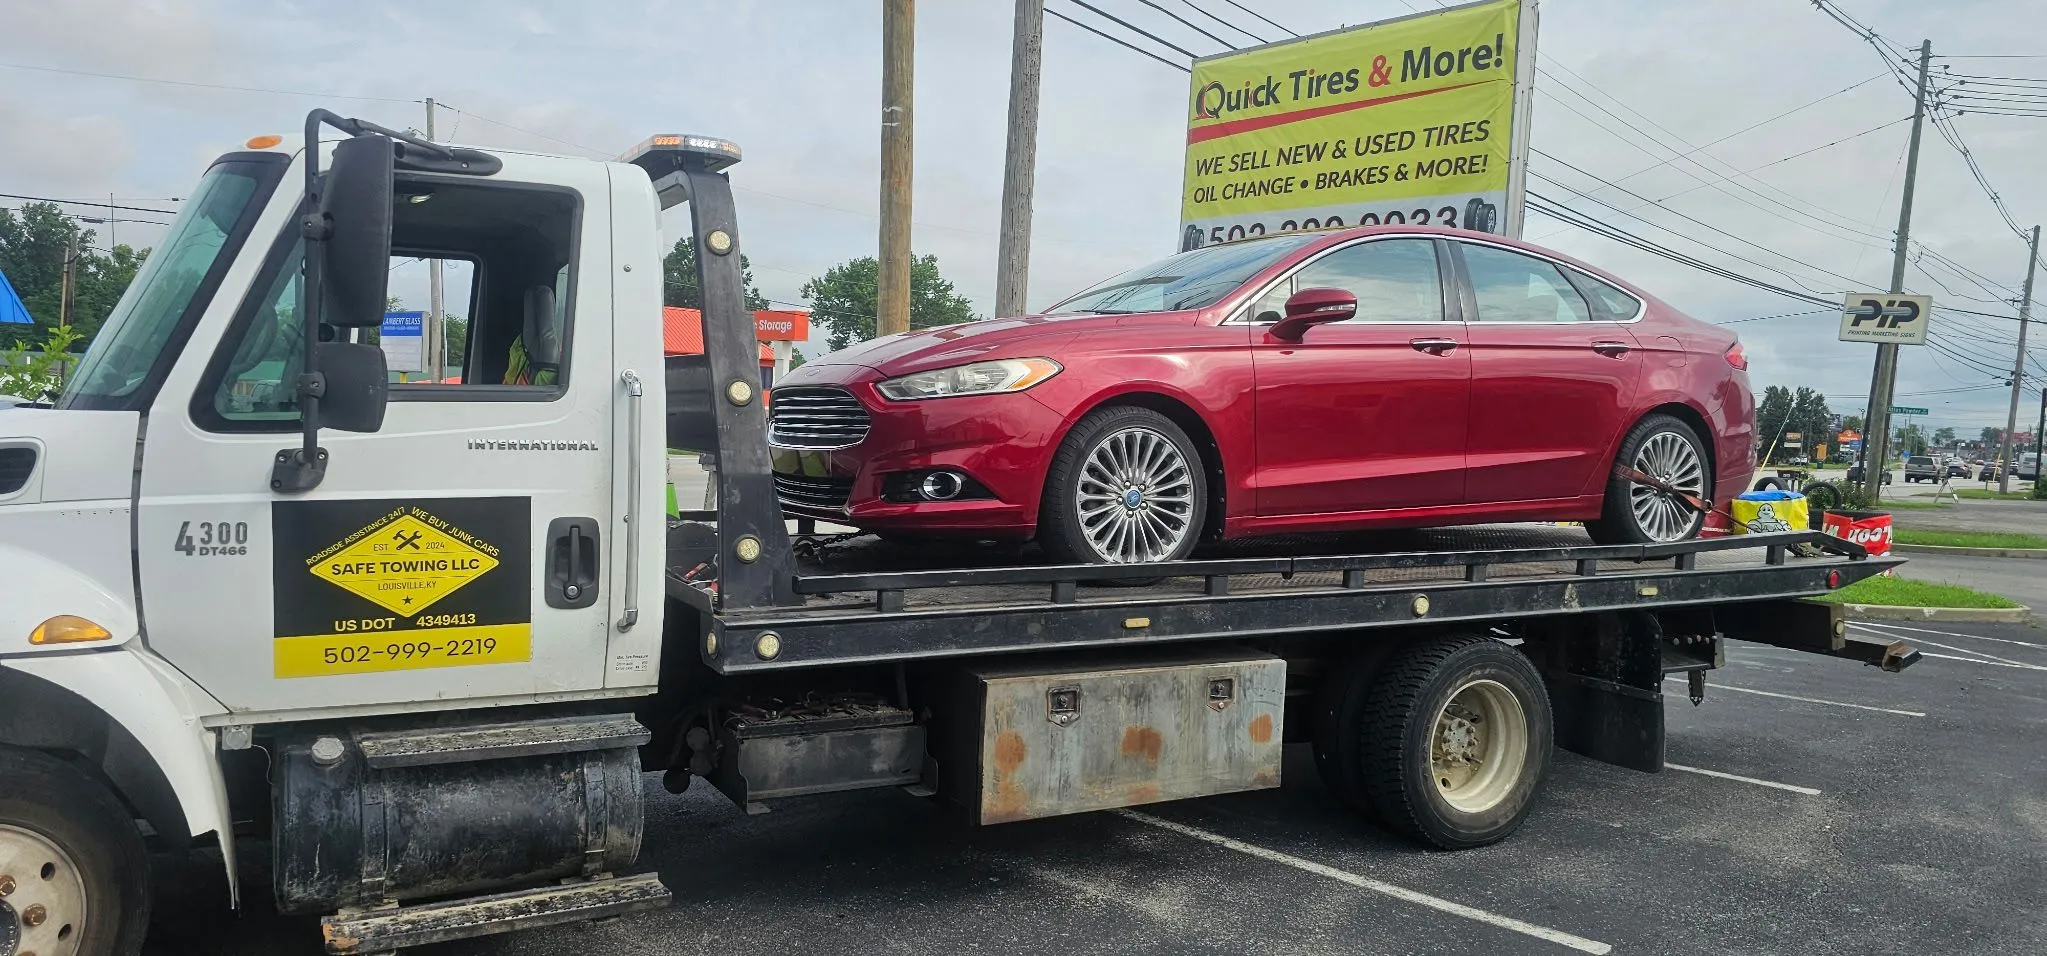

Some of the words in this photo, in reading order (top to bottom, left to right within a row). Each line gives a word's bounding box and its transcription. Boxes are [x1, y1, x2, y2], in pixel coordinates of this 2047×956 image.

[1195, 76, 1282, 119] Quick
[1289, 69, 1360, 101] Tires
[1368, 55, 1392, 88] &
[1400, 33, 1503, 82] More!
[1196, 156, 1225, 176] WE
[1228, 151, 1270, 172] SELL
[1276, 141, 1328, 167] NEW
[1331, 139, 1347, 159] &
[1354, 131, 1416, 157] USED
[1423, 120, 1491, 148] TIRES
[1193, 187, 1218, 204] OIL
[1222, 177, 1295, 201] CHANGE
[1315, 166, 1389, 190] BRAKES
[1393, 163, 1409, 181] &
[1414, 155, 1489, 180] MORE!
[759, 319, 792, 334] Storage
[1850, 299, 1920, 328] PIP
[467, 438, 598, 451] INTERNATIONAL
[306, 541, 346, 566] ROADSIDE
[344, 516, 389, 545] ASSISTANCE
[388, 506, 405, 520] 24/7
[411, 506, 428, 520] WE
[428, 515, 449, 530] BUY
[448, 527, 474, 544] JUNK
[474, 539, 500, 557] CARS
[199, 546, 248, 556] DT466
[373, 543, 389, 551] EST
[425, 541, 445, 550] 2024
[331, 562, 376, 576] SAFE
[380, 560, 448, 573] TOWING
[452, 558, 480, 571] LLC
[334, 619, 358, 632] US
[361, 617, 396, 630] DOT
[416, 613, 476, 627] 4349413
[324, 637, 497, 664] 502-999-2219
